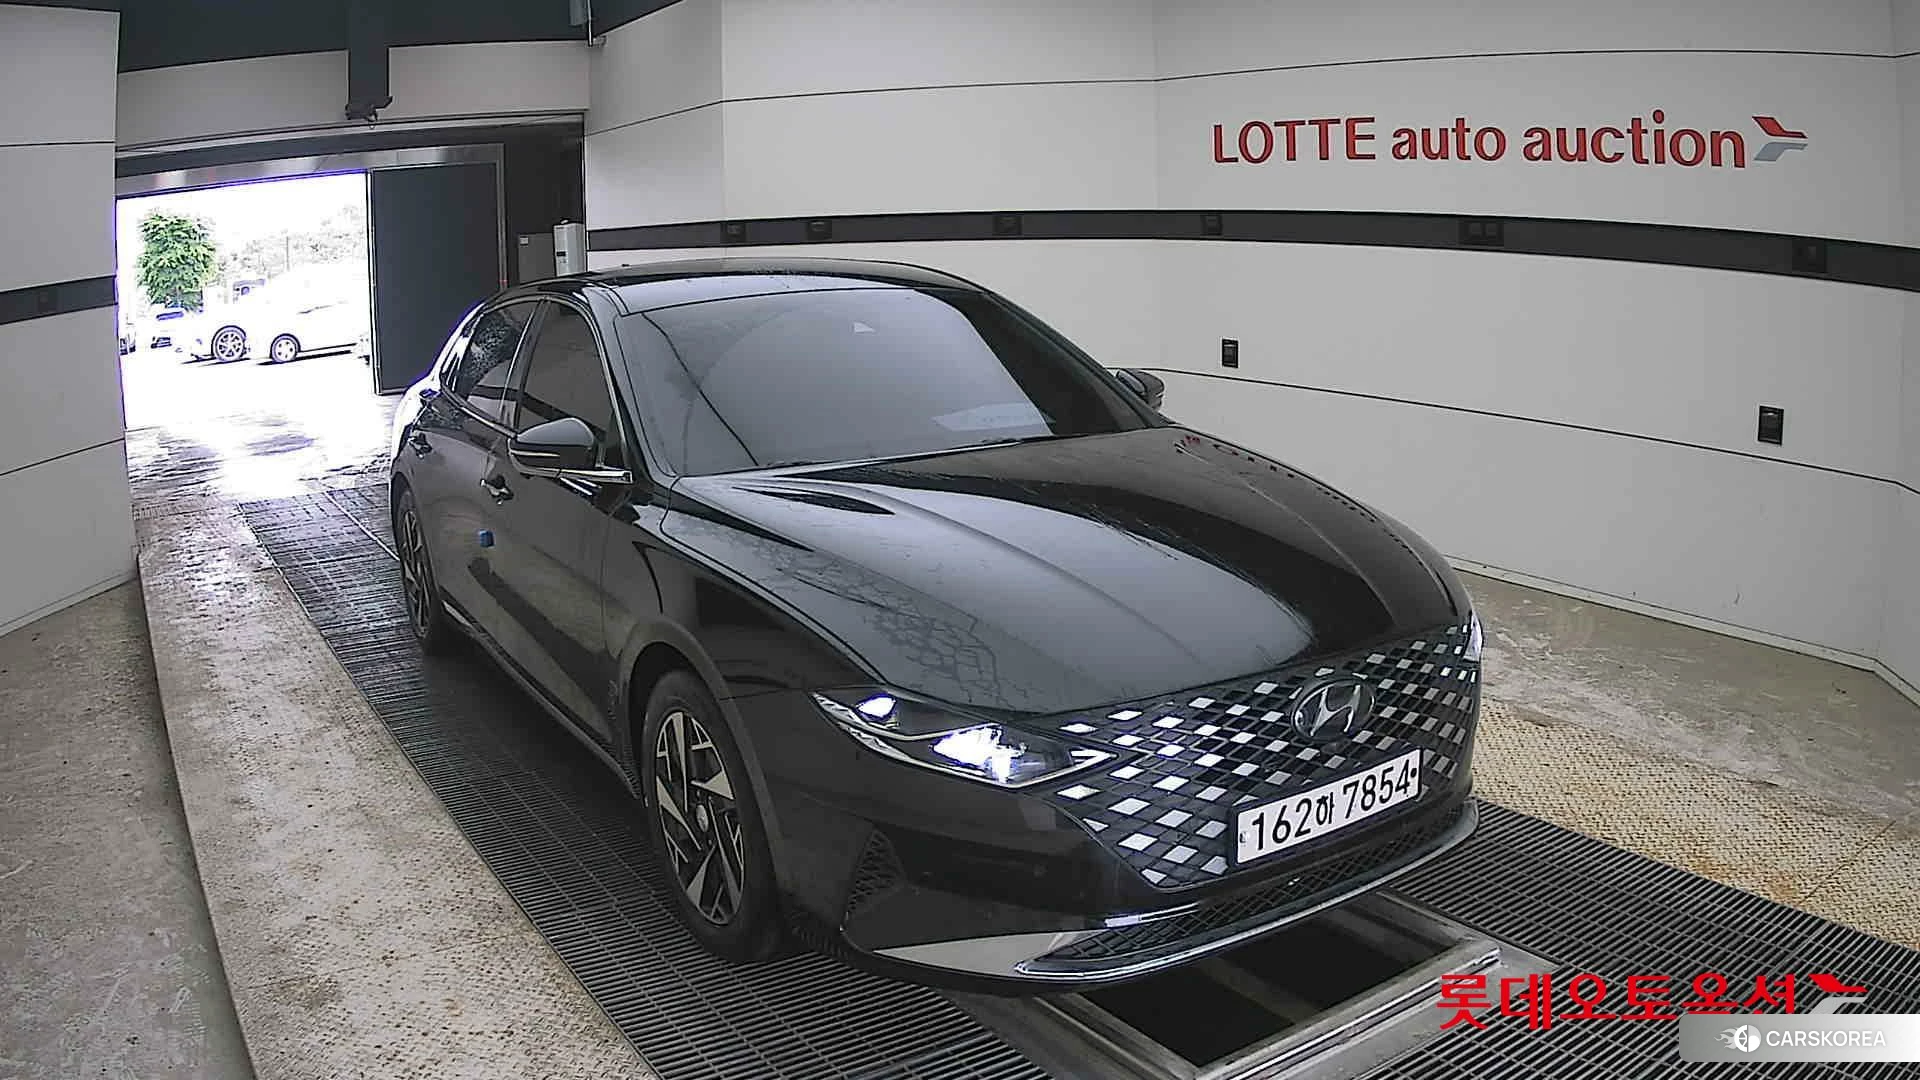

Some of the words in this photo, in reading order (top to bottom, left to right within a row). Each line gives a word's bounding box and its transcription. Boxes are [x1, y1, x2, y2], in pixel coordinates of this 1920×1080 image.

[1213, 116, 1376, 164] LOTTE
[1391, 117, 1506, 161] auto
[1522, 109, 1746, 169] auction
[1251, 791, 1335, 851] 162하
[1342, 758, 1411, 820] 7854
